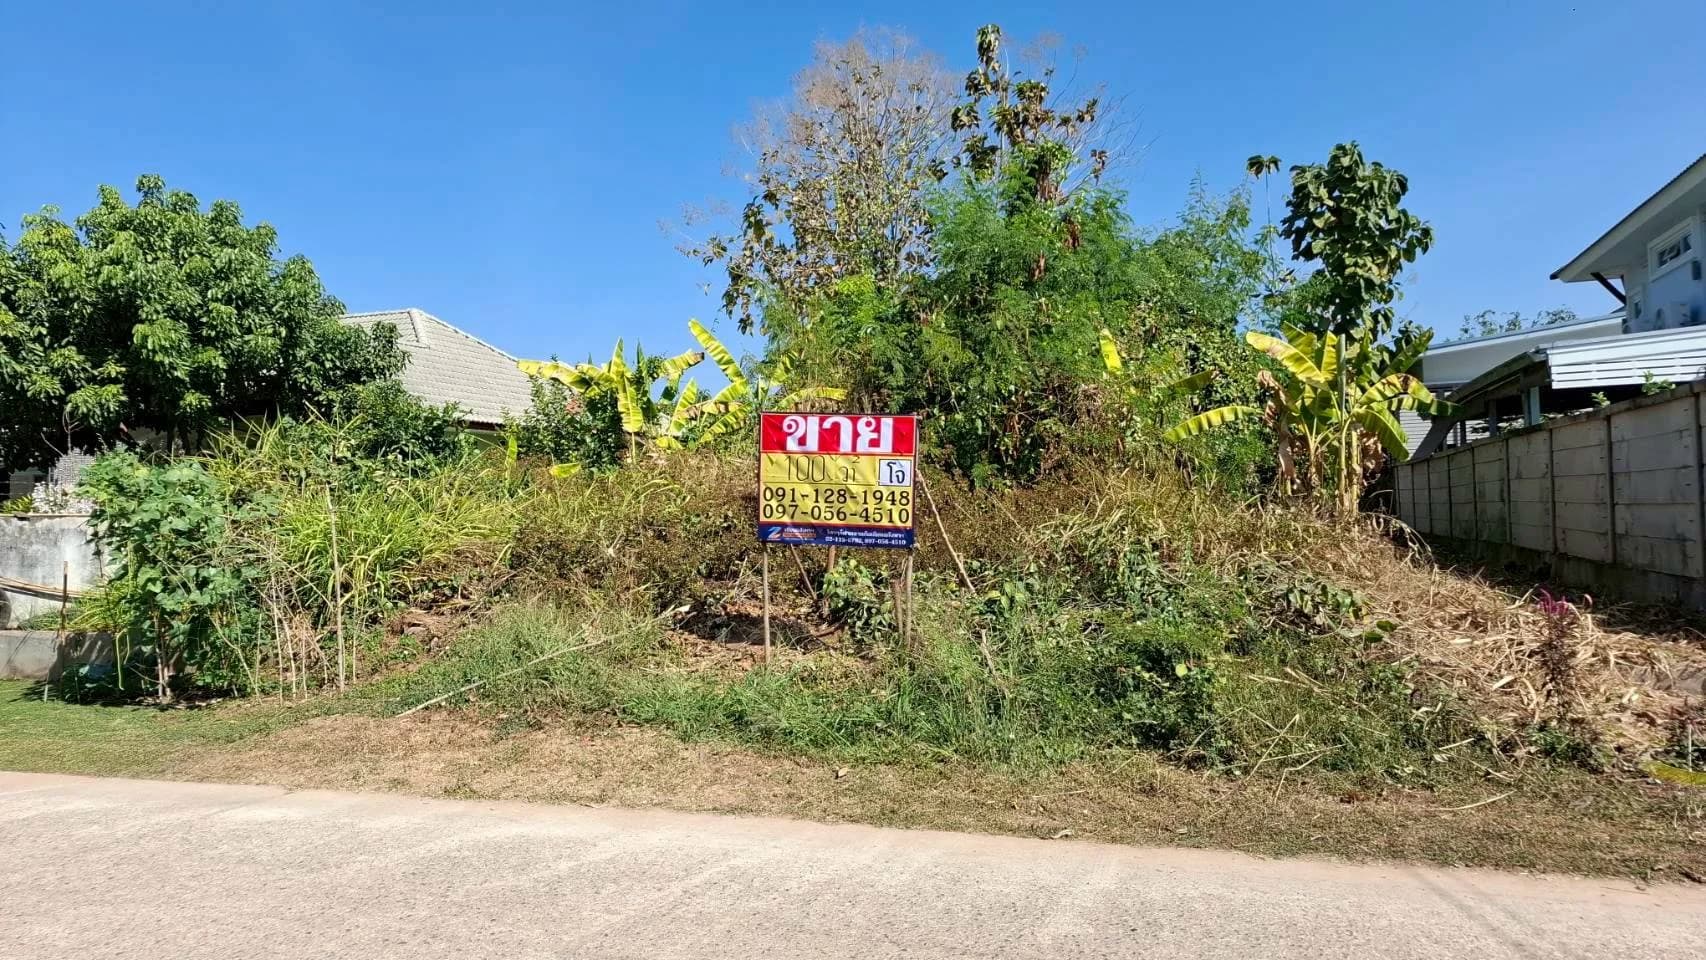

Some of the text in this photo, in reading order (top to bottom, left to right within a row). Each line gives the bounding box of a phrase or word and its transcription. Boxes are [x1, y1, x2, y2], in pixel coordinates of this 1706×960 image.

[782, 415, 894, 453] ขาย
[785, 455, 825, 482] 100
[763, 486, 910, 506] 091-128-1948
[763, 503, 910, 524] 097-056-4510
